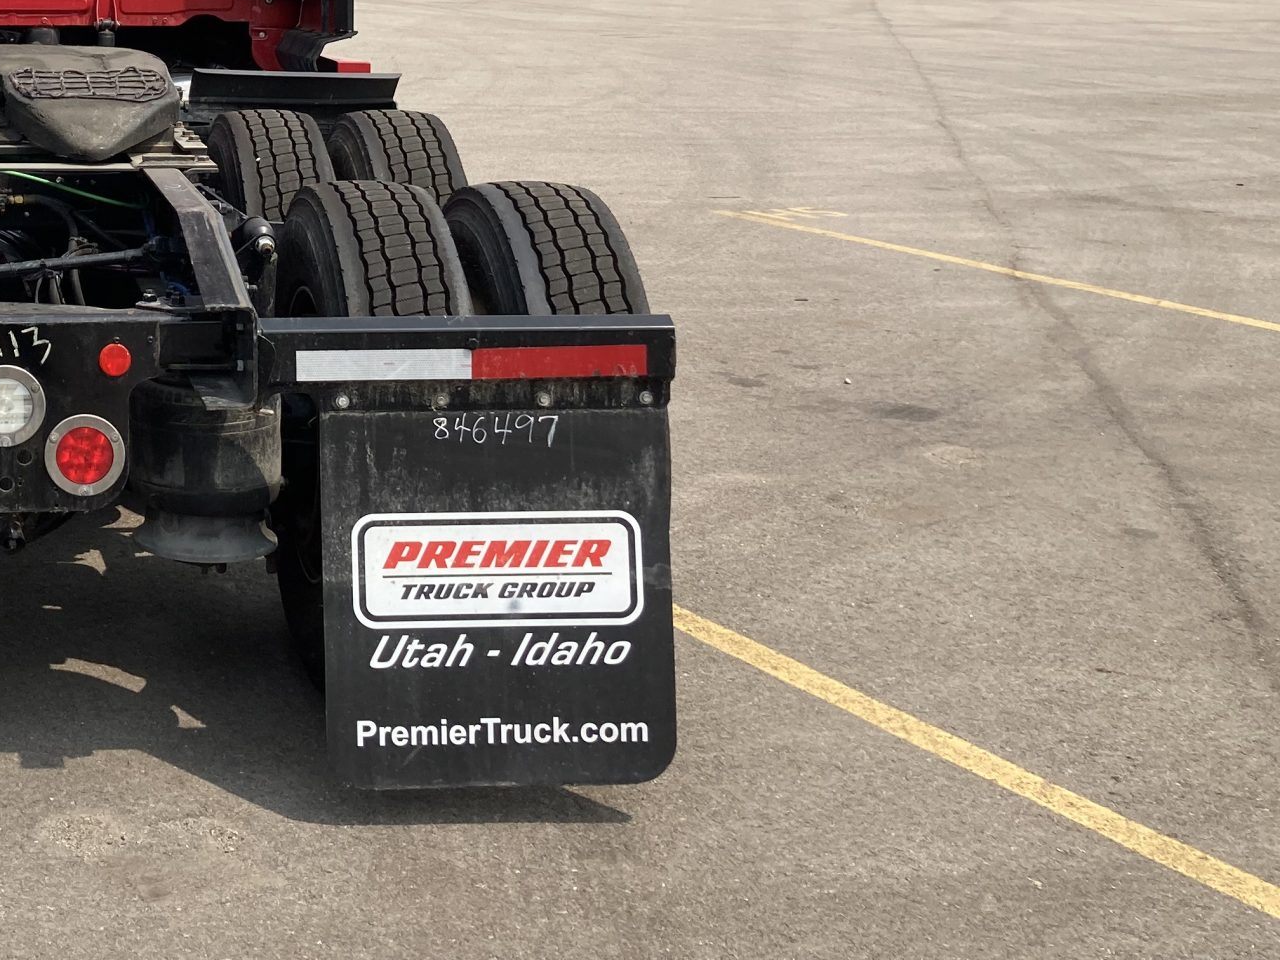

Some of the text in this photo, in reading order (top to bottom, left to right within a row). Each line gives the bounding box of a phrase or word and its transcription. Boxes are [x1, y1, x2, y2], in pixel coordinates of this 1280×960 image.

[433, 412, 560, 448] 846497
[382, 539, 613, 570] PREMIER
[400, 581, 596, 600] TRUCK GROUP
[368, 633, 475, 670] Utah
[510, 632, 633, 667] Idaho
[355, 716, 649, 747] PremierTruck.com
